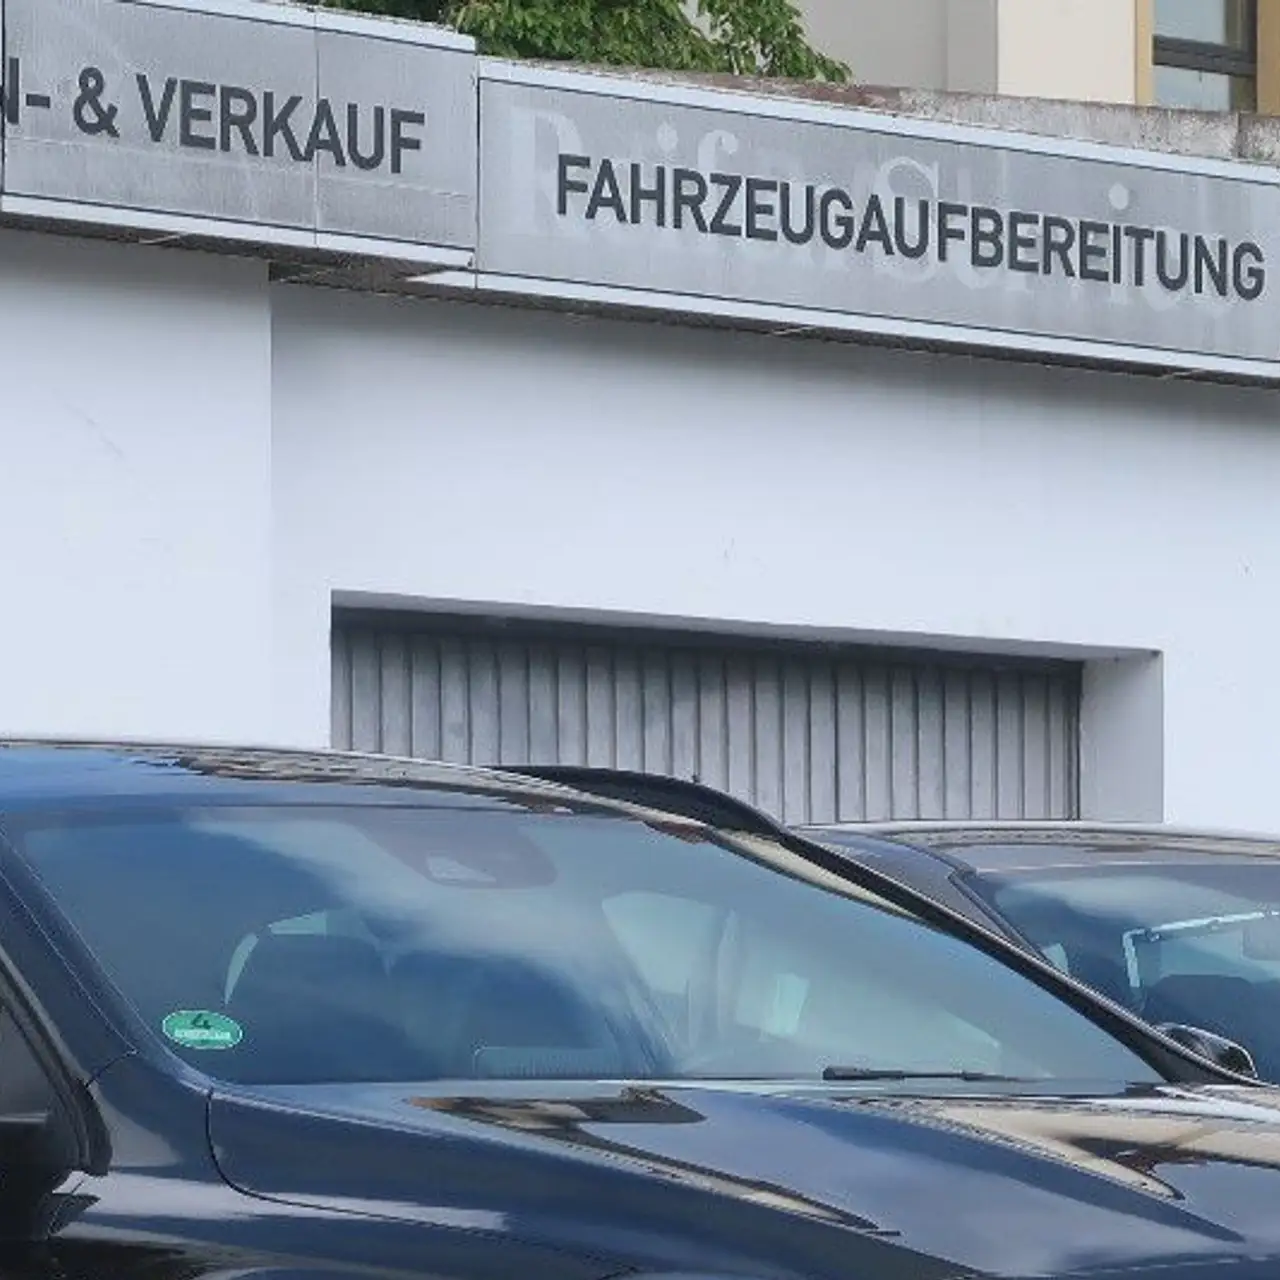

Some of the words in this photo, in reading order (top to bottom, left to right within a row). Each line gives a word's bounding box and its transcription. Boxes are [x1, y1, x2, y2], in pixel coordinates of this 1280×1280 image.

[73, 65, 121, 138] &
[136, 72, 426, 174] VERKAUF
[556, 153, 1266, 302] FAHRZEUGAUFBEREITUNG
